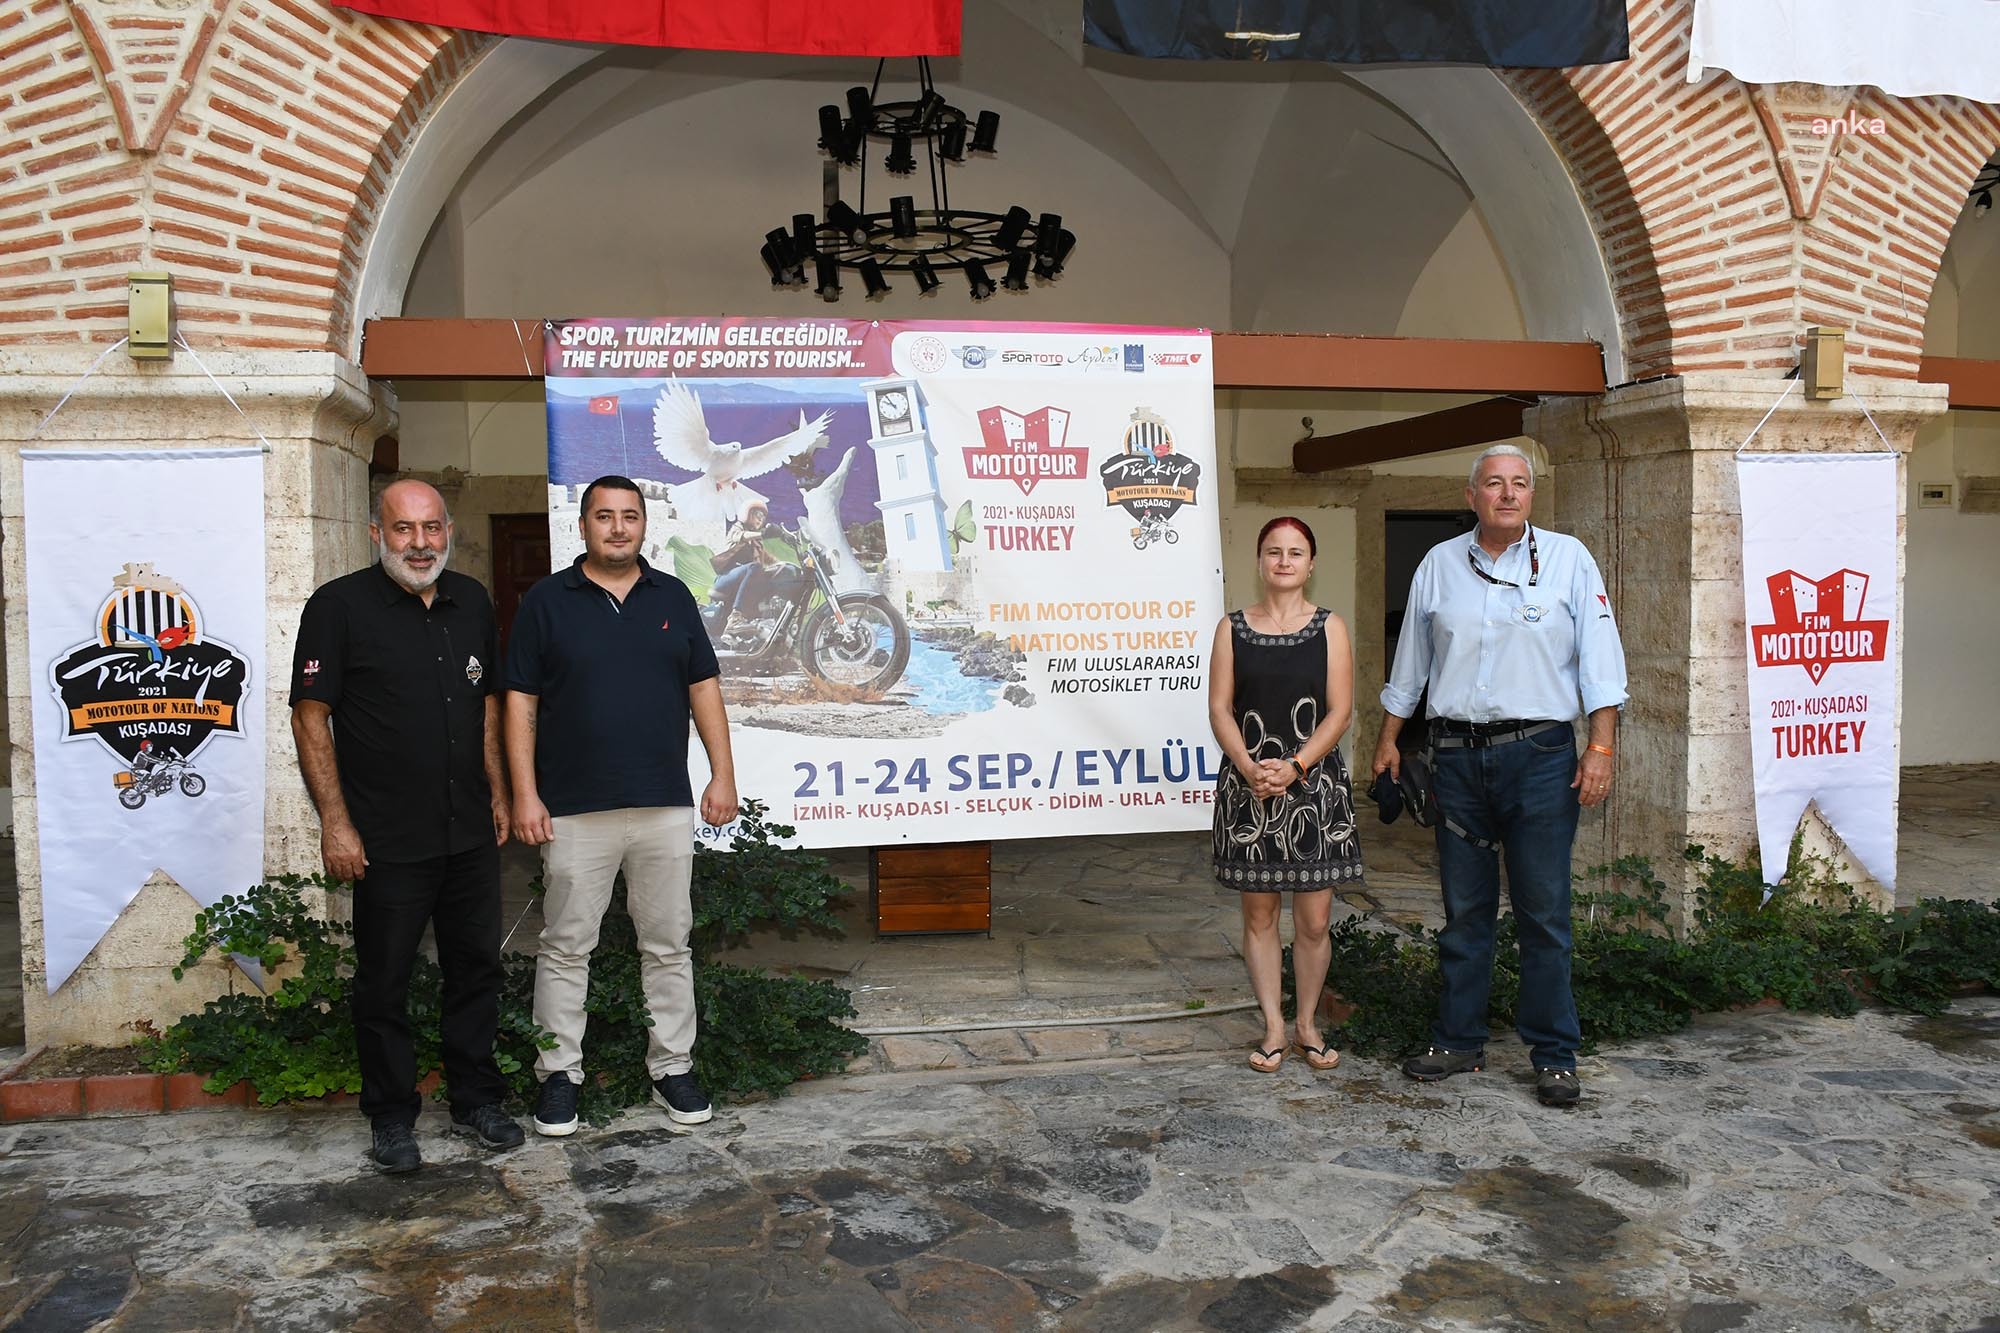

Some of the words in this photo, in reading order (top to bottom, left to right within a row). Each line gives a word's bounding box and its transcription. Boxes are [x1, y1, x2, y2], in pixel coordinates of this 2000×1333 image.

[560, 326, 619, 348] SPOR,
[625, 324, 720, 346] TURİZMİN
[724, 324, 864, 346] GELECEĞİDİR...
[562, 350, 594, 368] THE
[599, 350, 668, 368] FUTURE
[672, 350, 697, 368] OF
[700, 350, 770, 368] SPORTS
[774, 350, 866, 368] TOURISM...
[966, 351, 982, 362] FIM
[1164, 355, 1186, 363] TMF
[1014, 442, 1038, 452] FIM
[972, 454, 1078, 476] MOTOTOUR
[1103, 458, 1194, 492] Türkiye
[1116, 487, 1150, 496] MOTOTOUR
[1160, 487, 1186, 496] NATIONS
[1132, 498, 1172, 508] KUŞADASI
[983, 506, 1007, 519] 2021
[1016, 506, 1074, 522] KUŞADASI
[984, 526, 1074, 551] TURKEY
[990, 602, 1031, 622] FIM
[1036, 600, 1162, 622] MOTOTOUR
[1167, 600, 1196, 619] OF
[1804, 616, 1830, 630] FIM
[1010, 632, 1108, 652] NATIONS
[1112, 630, 1198, 650] TURKEY
[1762, 630, 1874, 662] MOTOTOUR
[1048, 658, 1076, 673] FIM
[1084, 654, 1200, 672] ULUSLARARASI
[62, 652, 233, 708] Türkiye
[1050, 675, 1152, 694] MOTOSİKLET
[1159, 676, 1201, 692] TURU
[138, 686, 167, 696] 2021
[87, 703, 150, 720] MOTOTOUR
[152, 702, 167, 714] OF
[171, 704, 220, 716] NATIONS
[1771, 700, 1795, 718] 2021
[1804, 695, 1868, 718] KUŞADASI
[118, 722, 192, 738] KUŞADASI
[1772, 720, 1866, 759] TURKEY
[794, 758, 931, 798] 21-24
[858, 800, 949, 820] KUŞADASI
[966, 797, 1032, 816] SELÇUK
[1050, 792, 1103, 810] DİDİM
[1120, 792, 1166, 806] URLA
